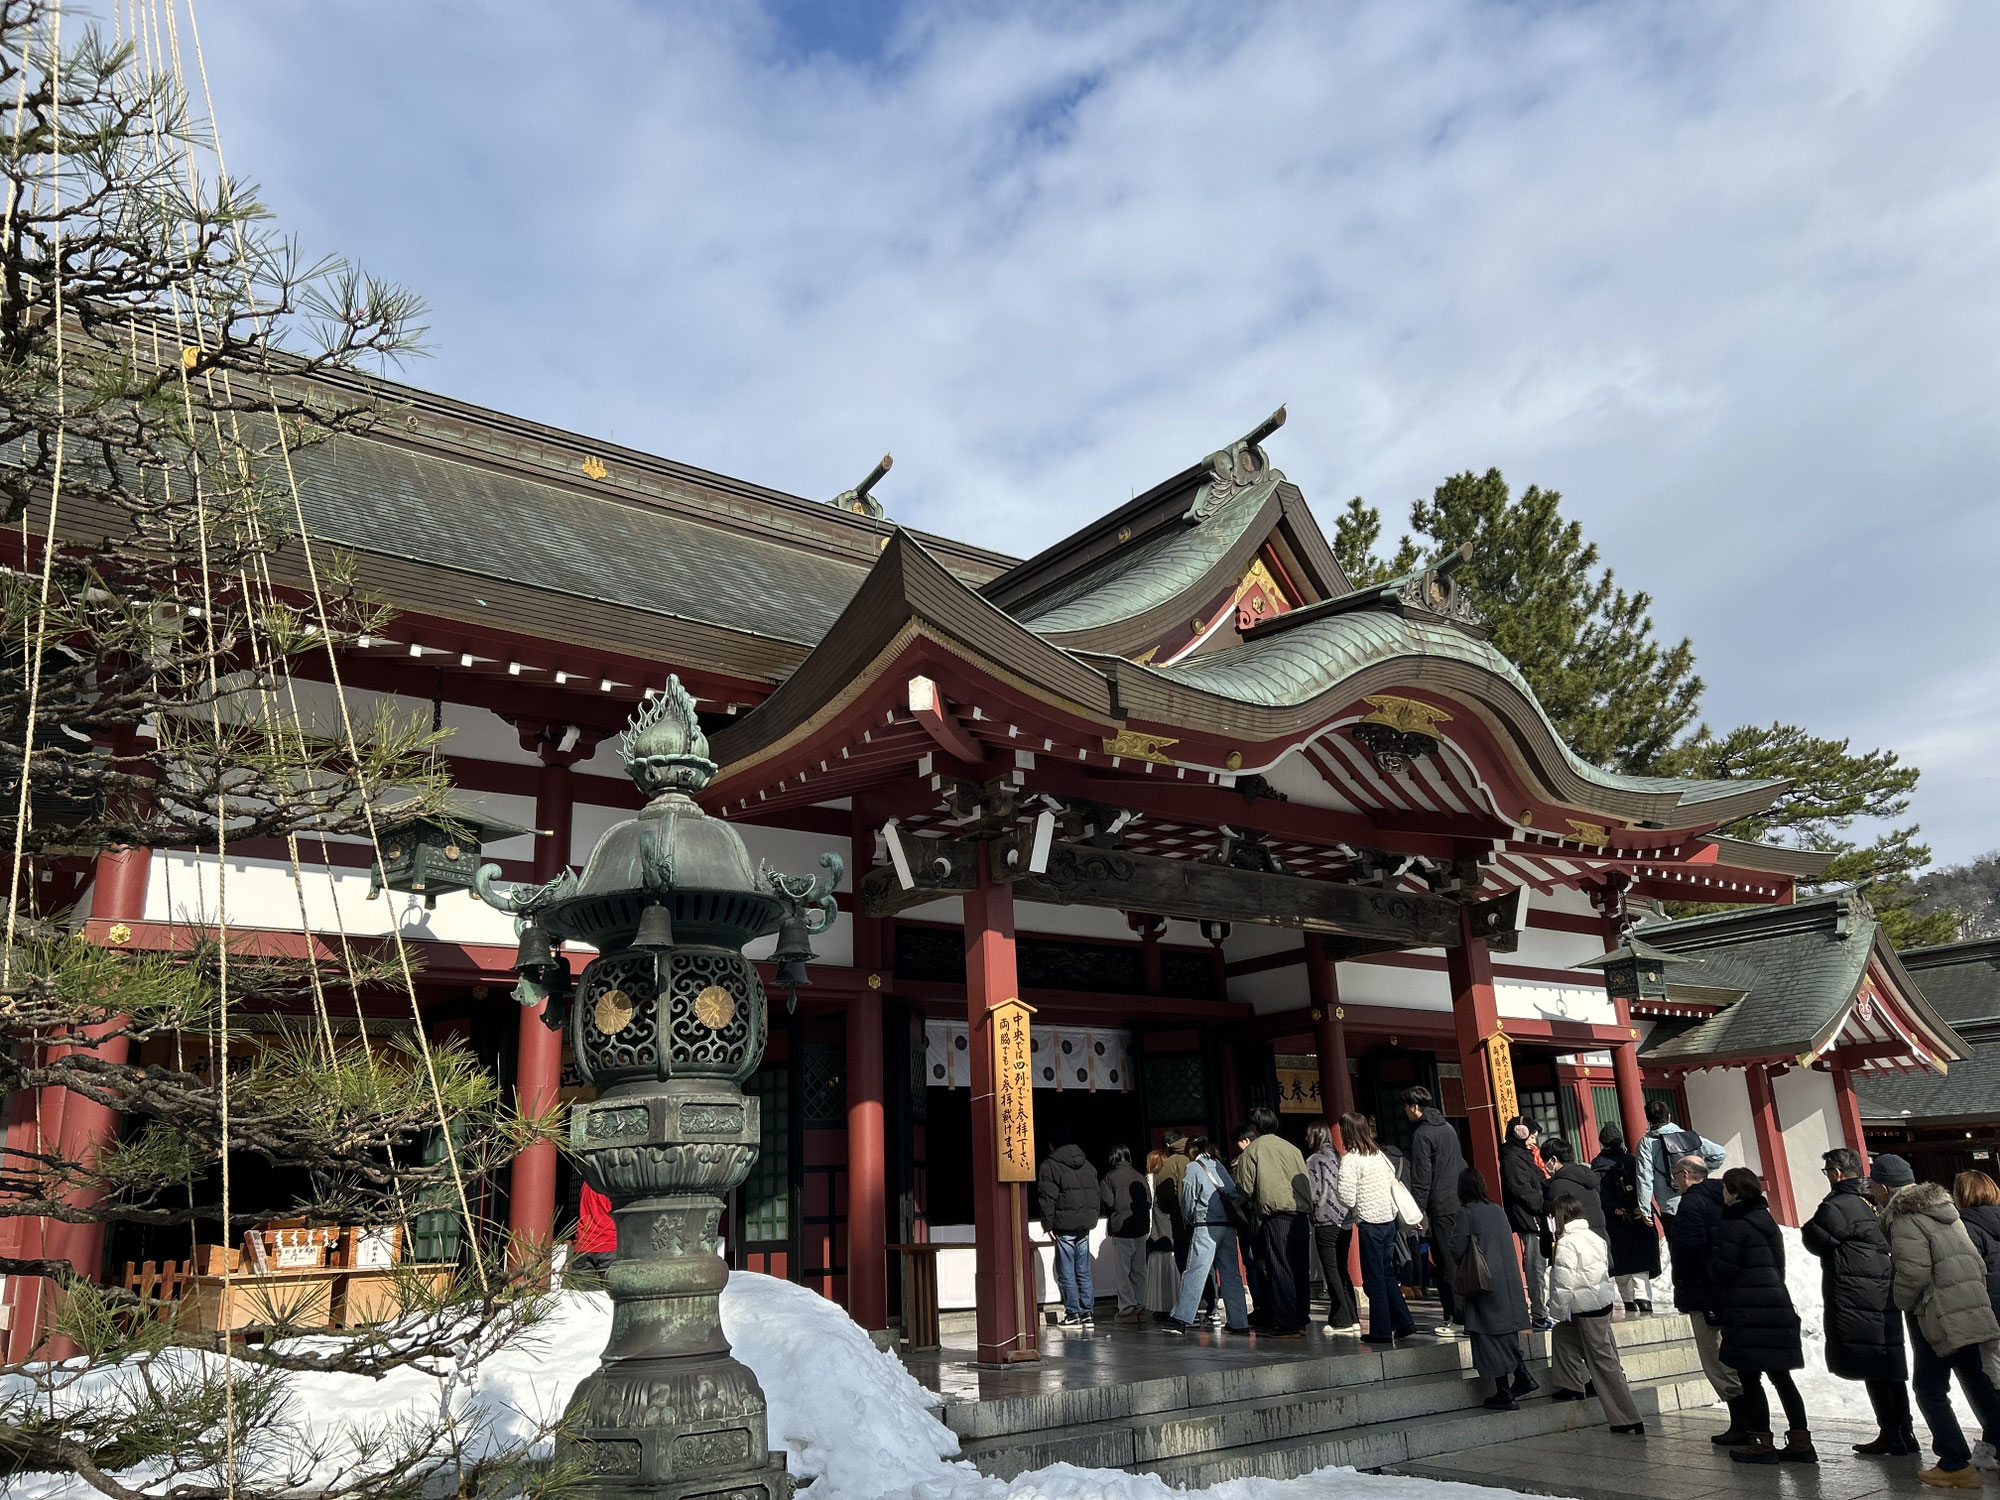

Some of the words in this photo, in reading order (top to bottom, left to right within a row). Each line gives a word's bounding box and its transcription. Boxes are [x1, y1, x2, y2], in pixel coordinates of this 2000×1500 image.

[1013, 1011, 1030, 1170] 中央では四列でご参拝下さい。
